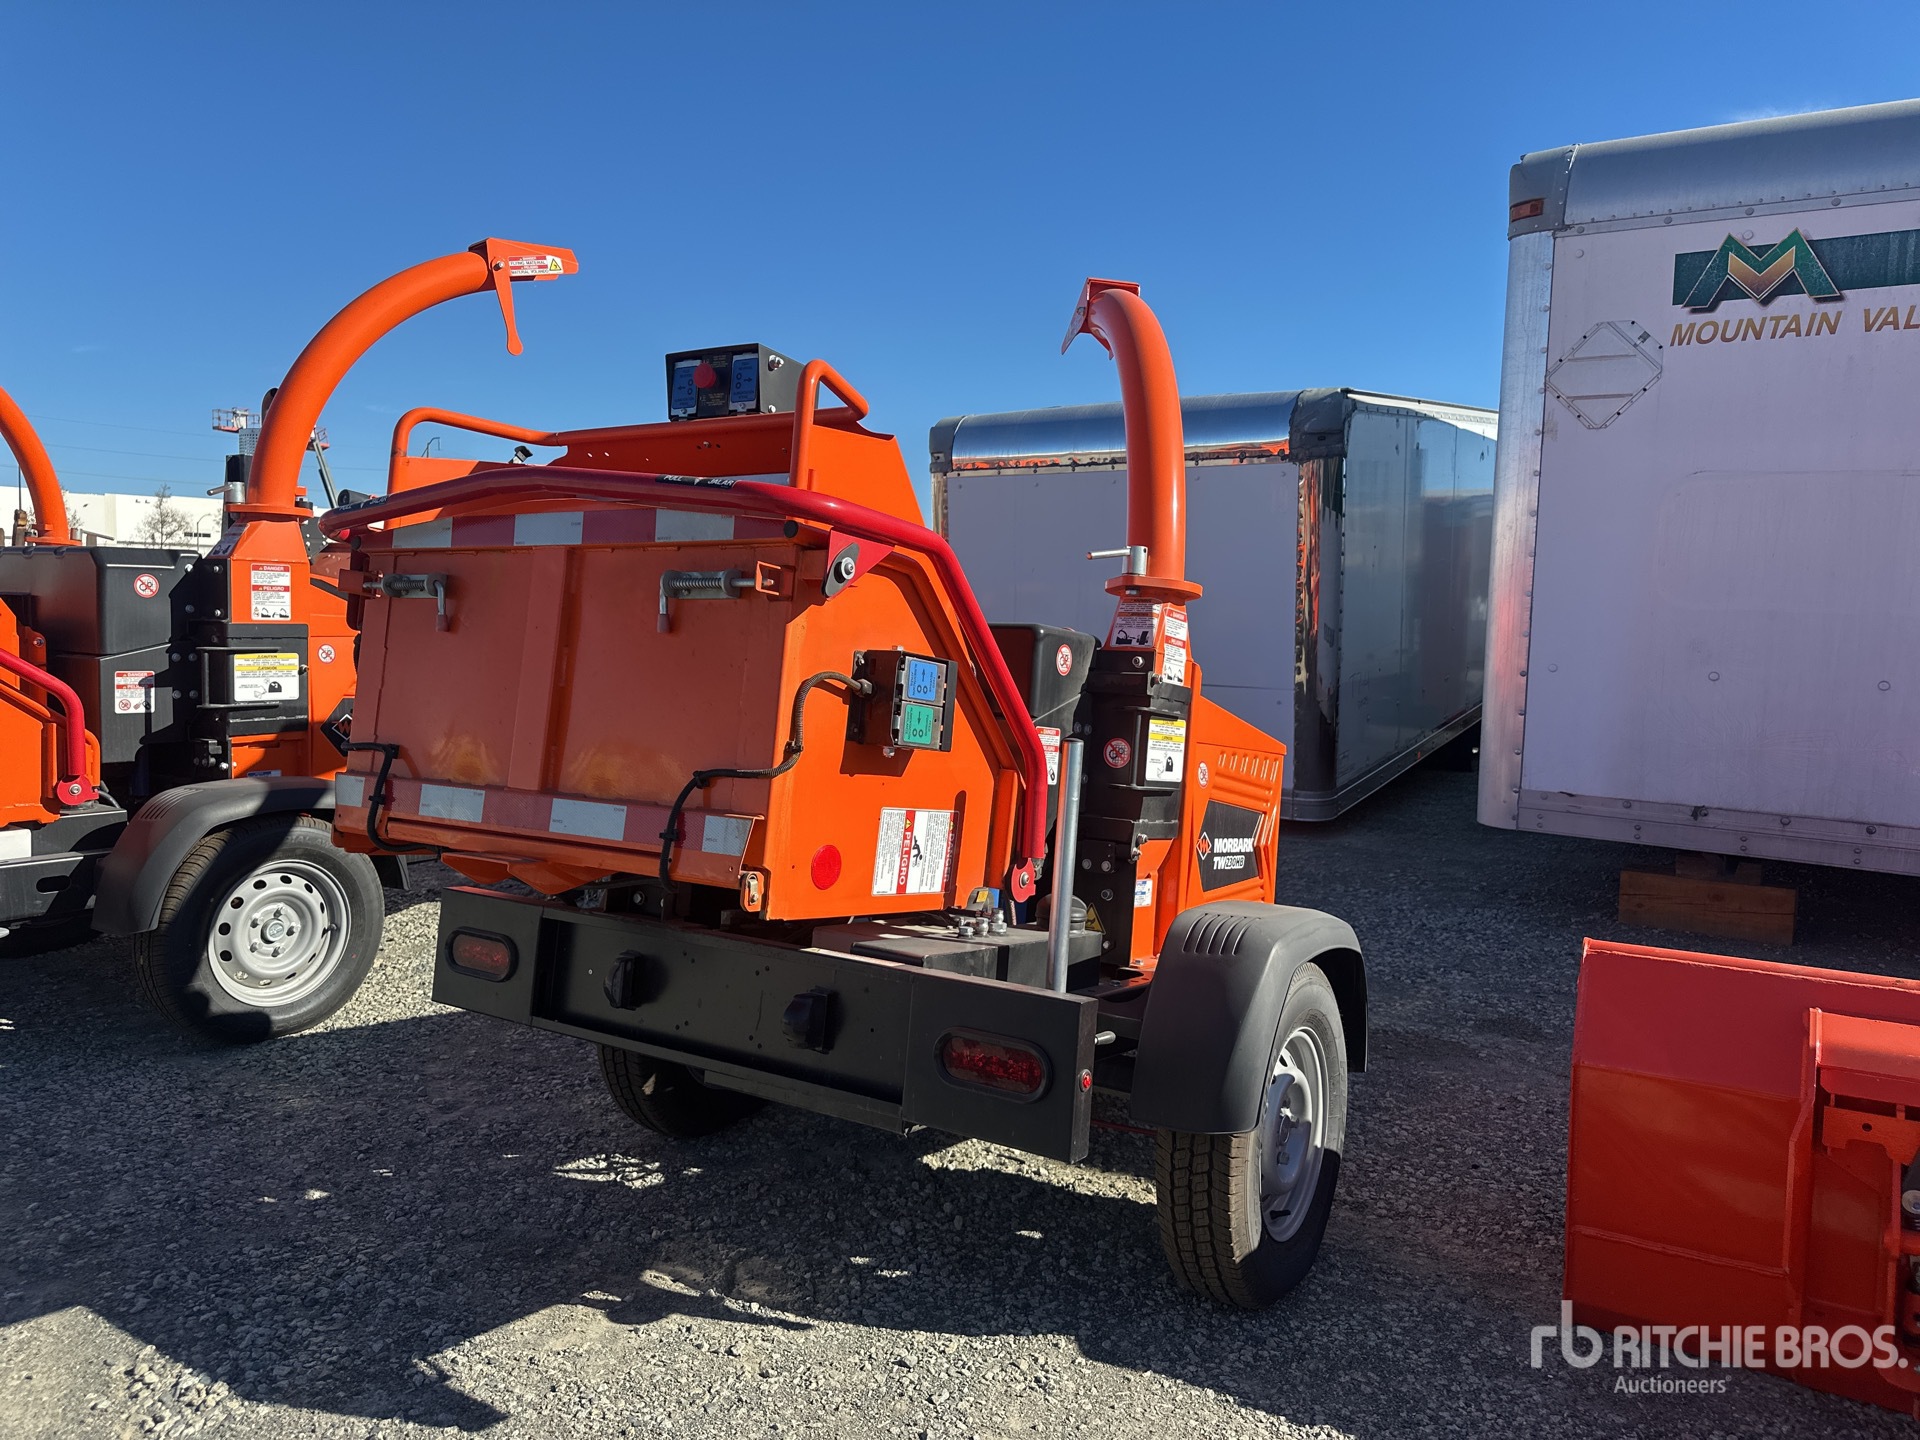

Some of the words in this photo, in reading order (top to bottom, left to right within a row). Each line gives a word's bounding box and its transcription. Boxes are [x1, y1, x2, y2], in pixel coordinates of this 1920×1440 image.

[1670, 310, 1843, 347] MOUNTAIN
[1863, 304, 1920, 333] VAL
[663, 474, 683, 482] PULL
[707, 478, 735, 486] JALAR
[898, 831, 912, 886] PELIGRO
[1213, 838, 1255, 853] MORBARK
